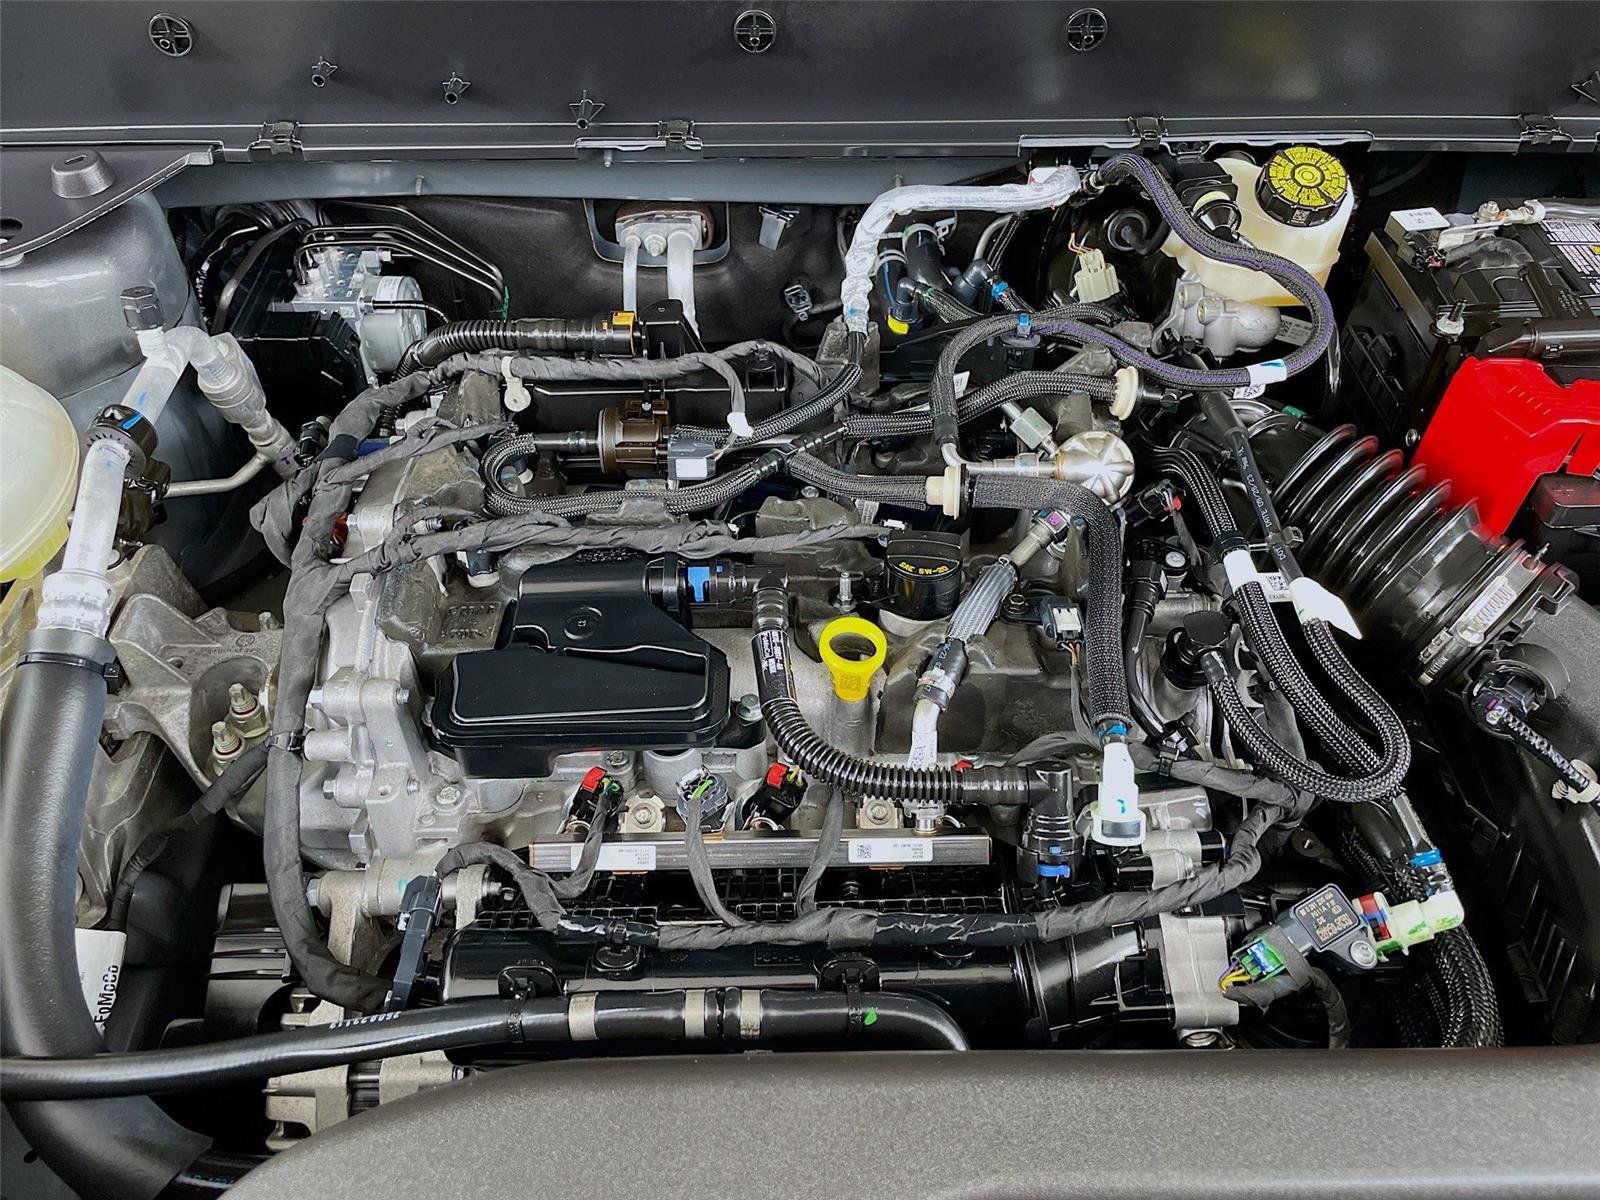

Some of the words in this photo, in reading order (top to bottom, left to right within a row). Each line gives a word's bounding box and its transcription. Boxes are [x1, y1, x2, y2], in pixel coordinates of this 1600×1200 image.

[1261, 509, 1272, 528] DATE
[899, 561, 915, 572] SAE
[918, 565, 949, 575] 5W-20
